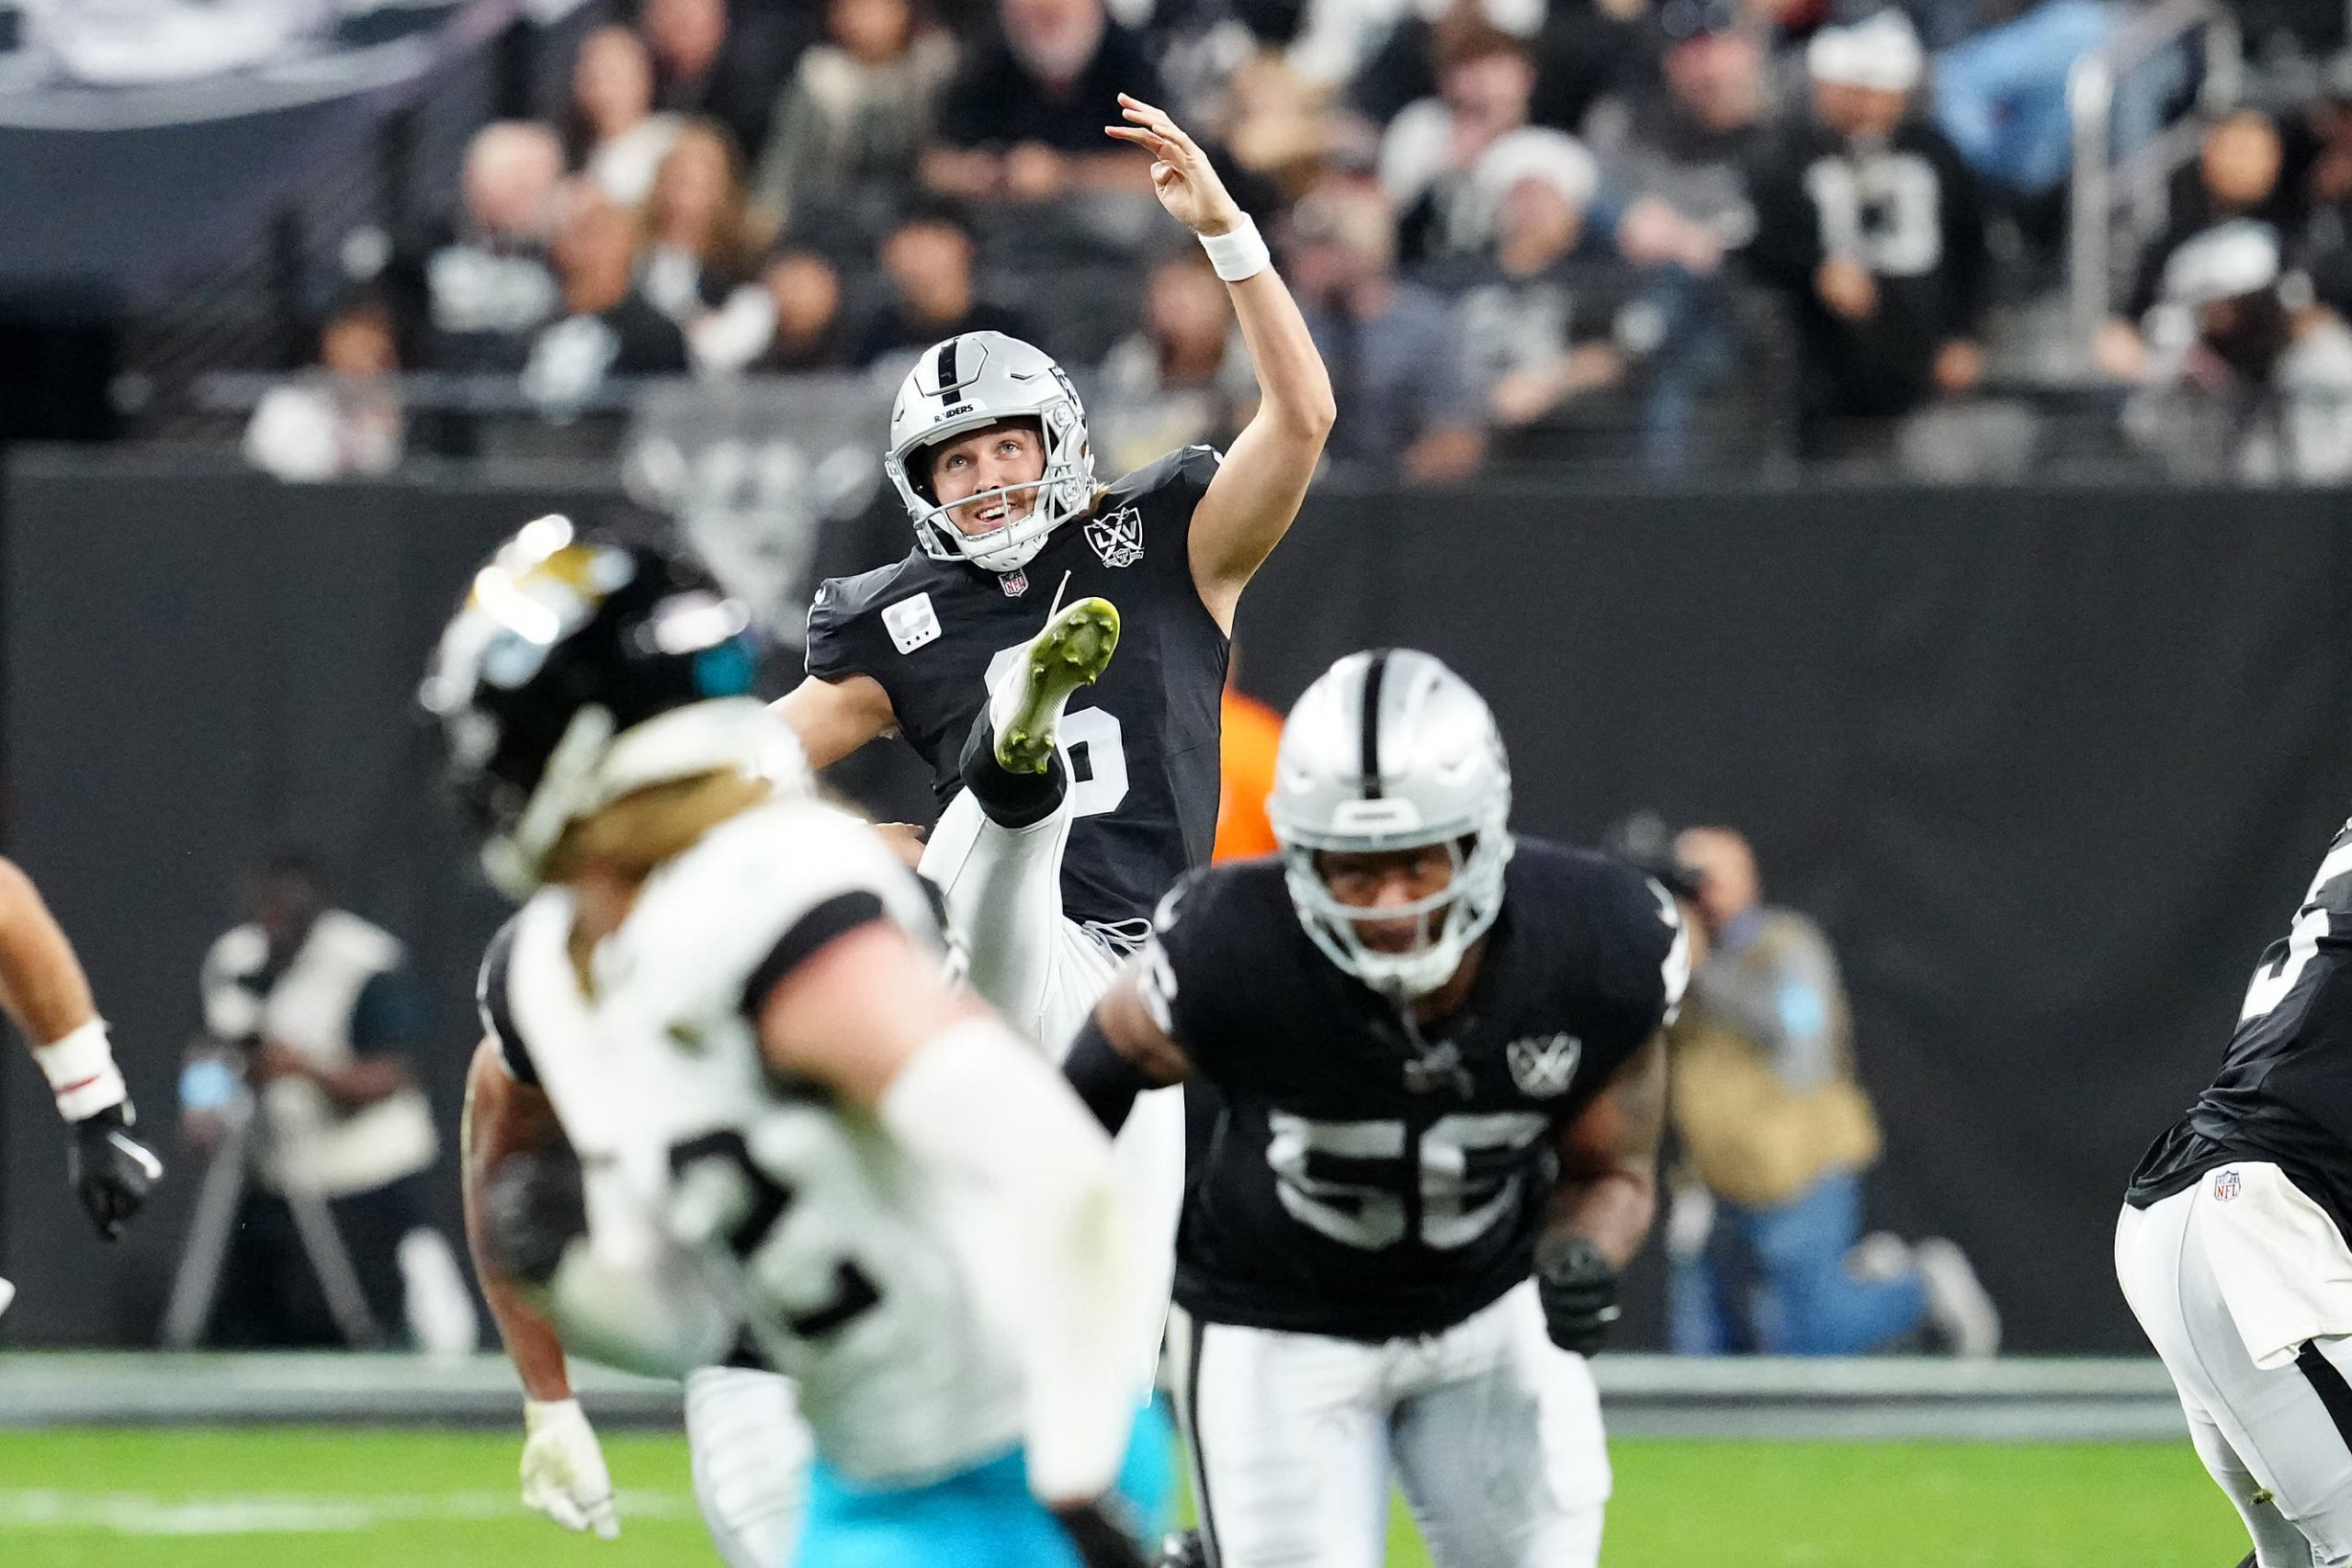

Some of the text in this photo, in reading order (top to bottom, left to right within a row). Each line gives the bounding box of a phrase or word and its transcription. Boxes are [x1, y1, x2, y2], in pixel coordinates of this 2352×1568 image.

[933, 404, 974, 423] RIDERS
[1004, 577, 1025, 593] NFL
[1266, 1108, 1553, 1251] 56
[2217, 1184, 2239, 1200] NFL
